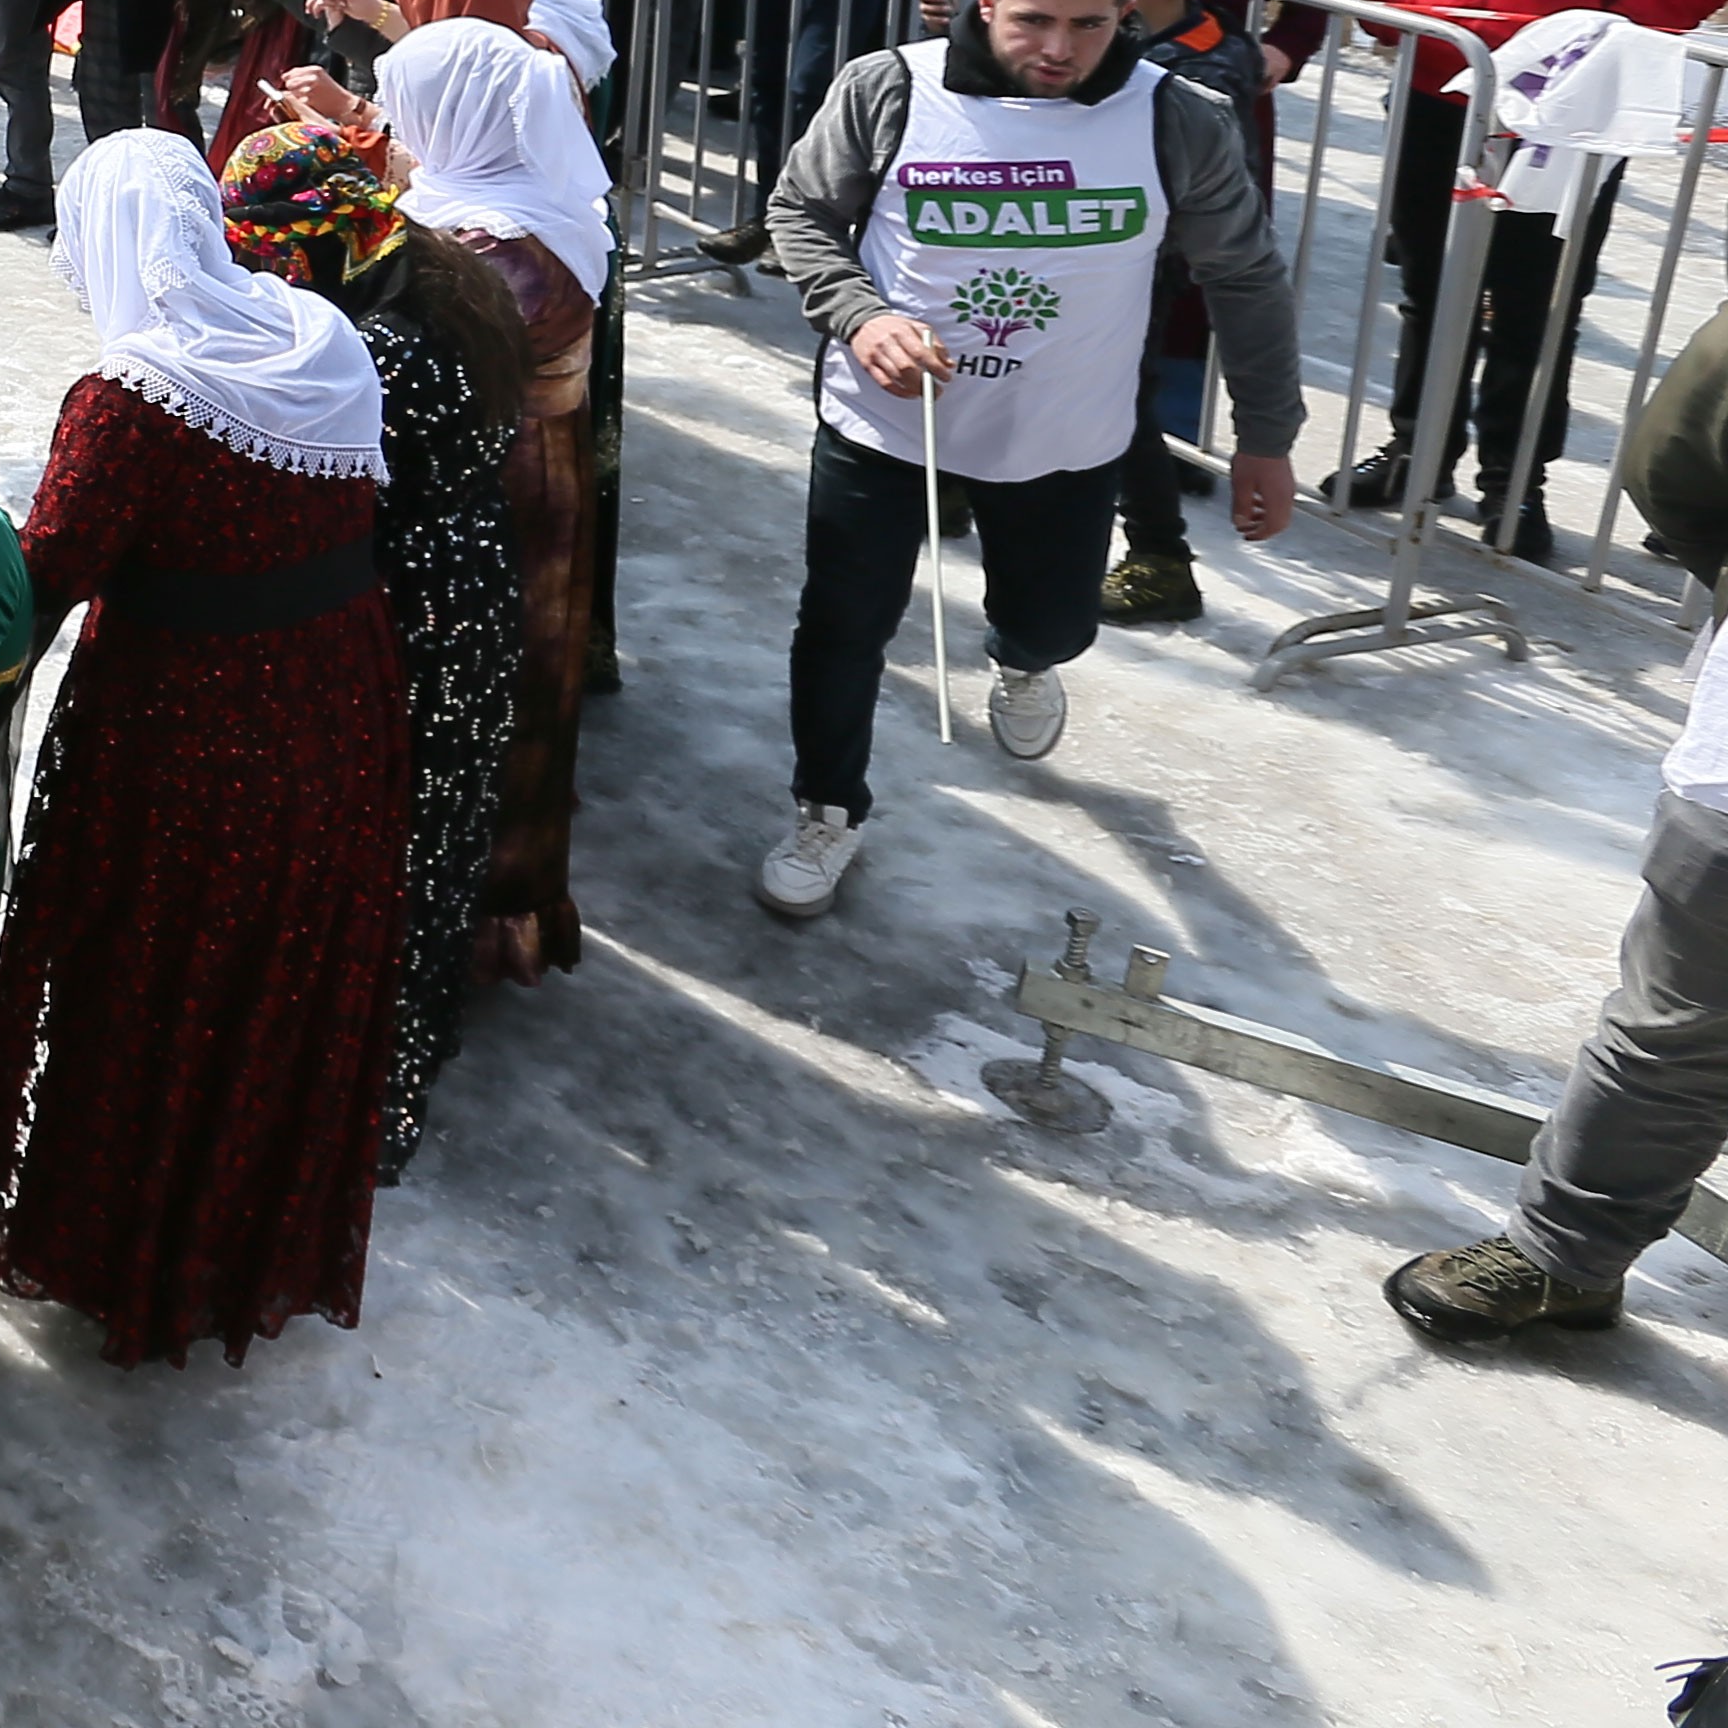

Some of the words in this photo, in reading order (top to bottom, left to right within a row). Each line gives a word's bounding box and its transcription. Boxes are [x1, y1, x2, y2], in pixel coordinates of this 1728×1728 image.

[907, 167, 1003, 186] herkes
[1010, 166, 1065, 186] için
[915, 198, 1137, 236] ADALET
